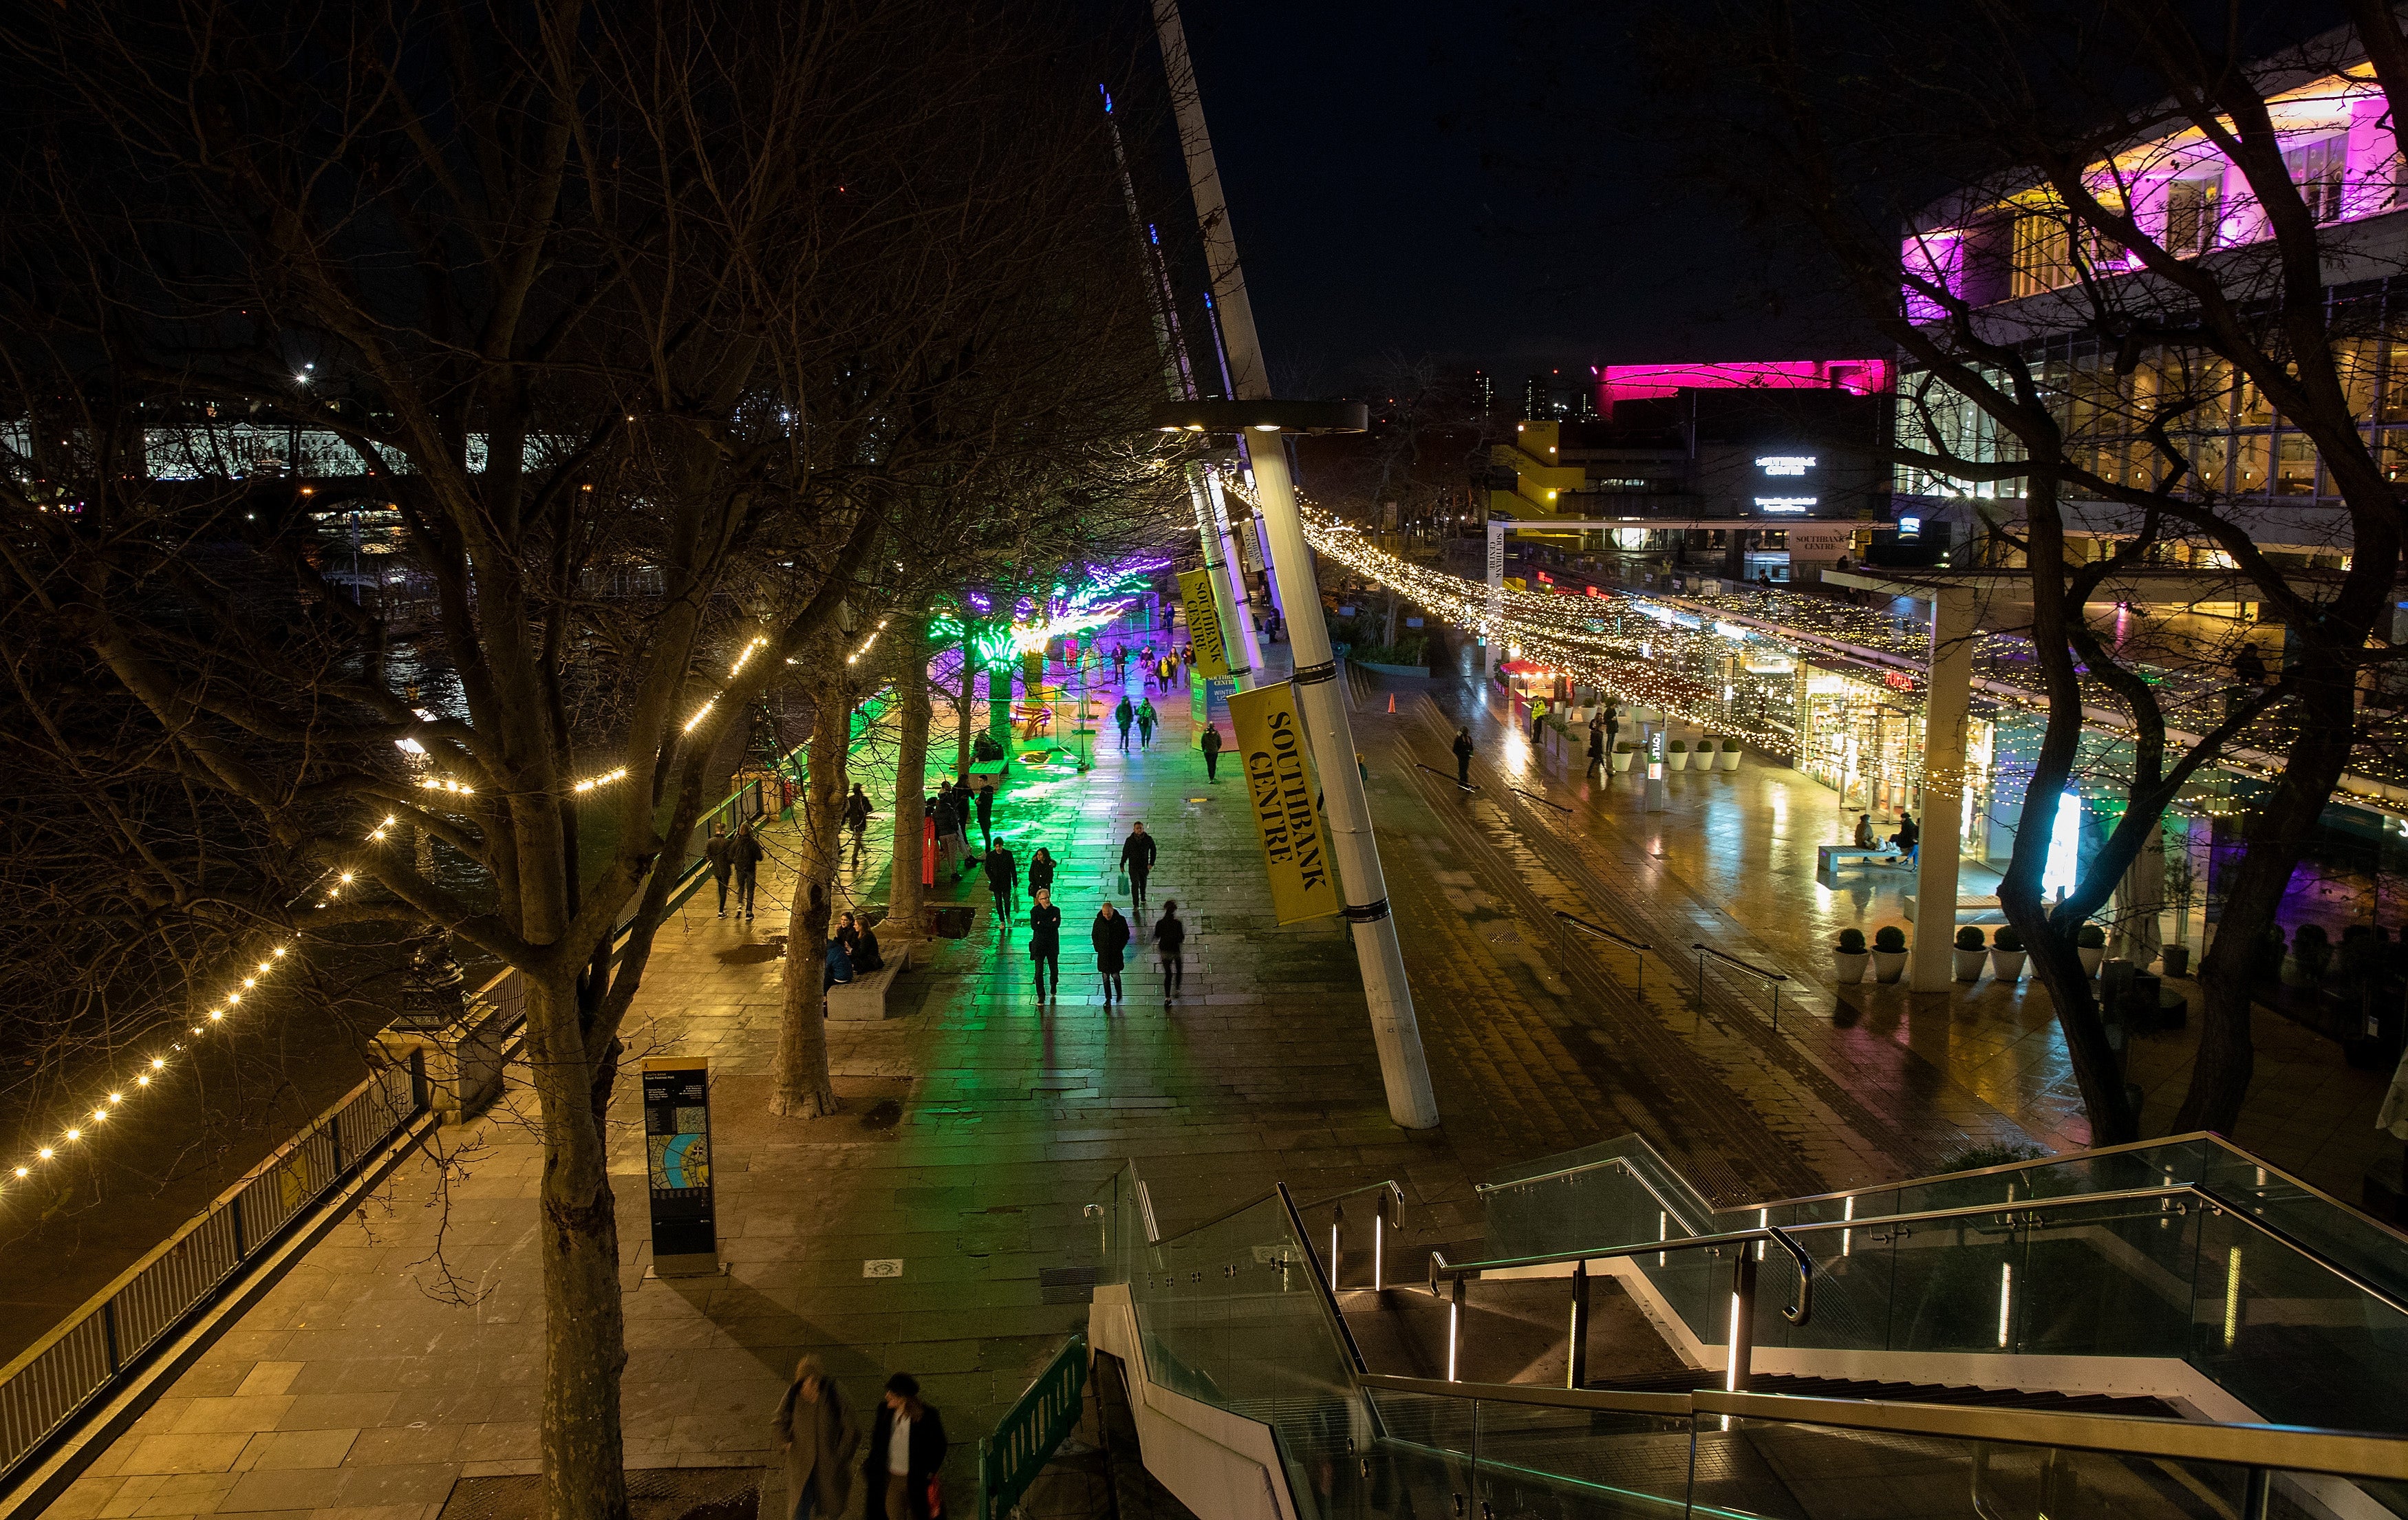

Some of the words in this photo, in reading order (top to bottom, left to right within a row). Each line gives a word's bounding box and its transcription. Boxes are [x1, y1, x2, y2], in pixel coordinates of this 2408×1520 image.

[1187, 599, 1207, 652] CENTRE
[1194, 581, 1223, 663] SOUTHBANK
[1652, 733, 1661, 760] FOYLES
[1249, 751, 1293, 865] CENTRE
[1267, 711, 1326, 892] SOUTHBANK
